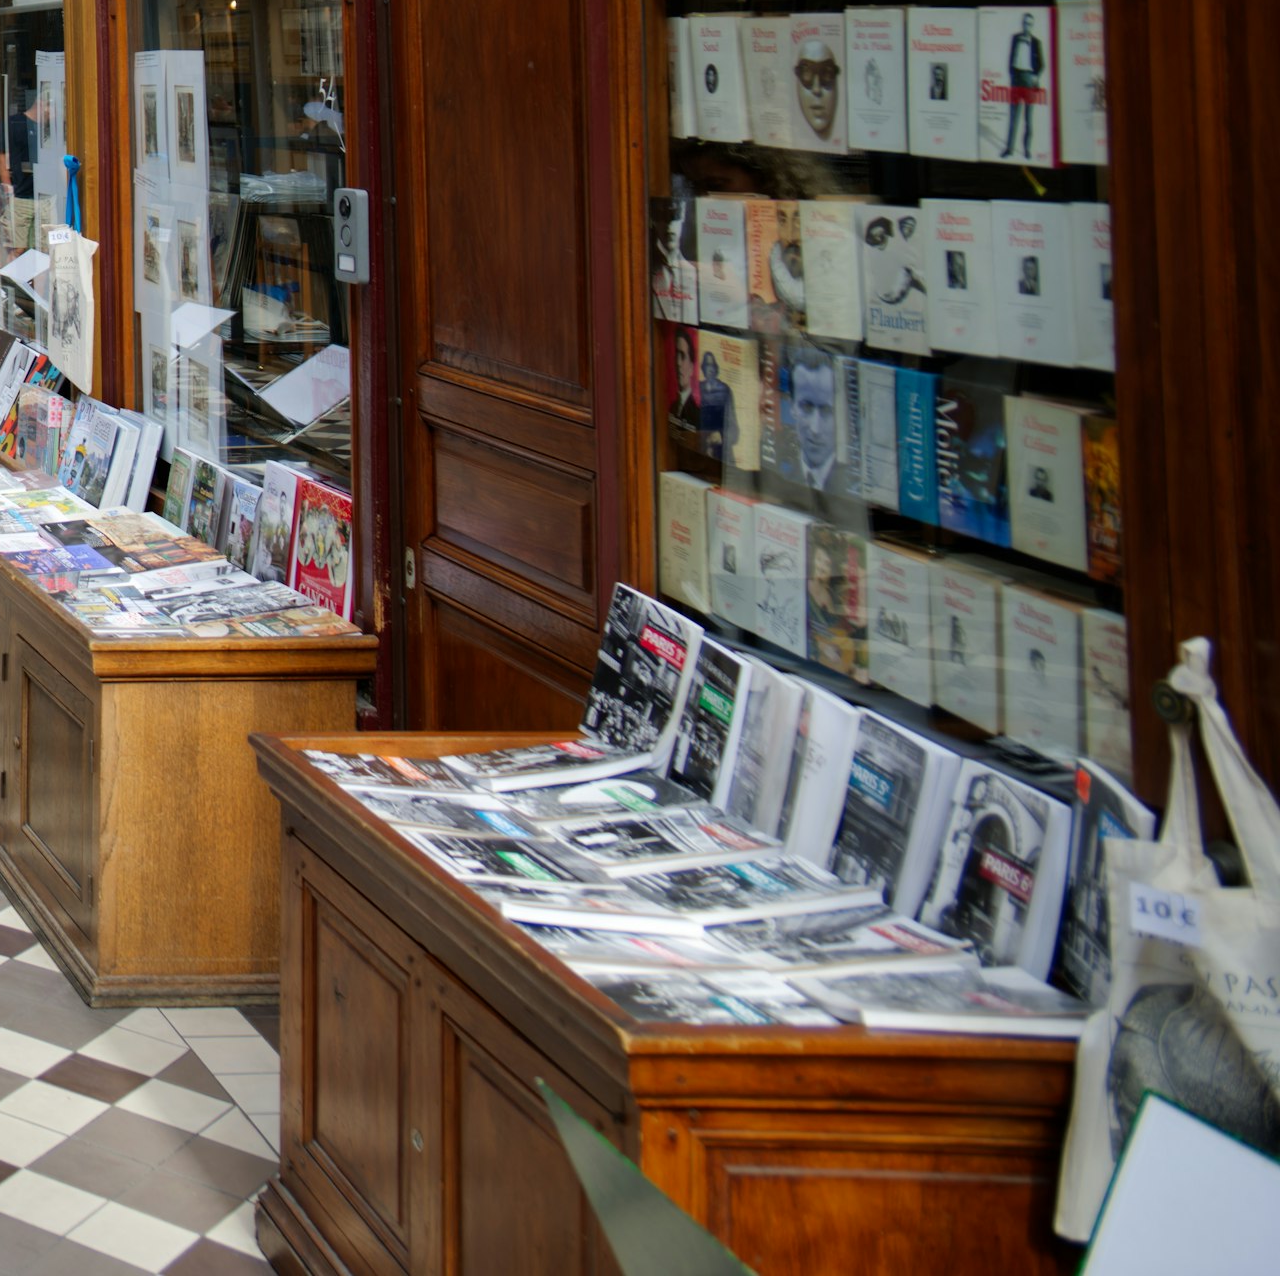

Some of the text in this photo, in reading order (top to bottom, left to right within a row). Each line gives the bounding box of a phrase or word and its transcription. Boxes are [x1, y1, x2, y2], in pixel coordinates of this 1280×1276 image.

[922, 23, 953, 37] Album
[319, 76, 336, 114] 54
[939, 211, 972, 226] Album
[751, 204, 765, 290] Montaigne
[869, 307, 926, 333] Flaubert
[935, 396, 961, 506] Molière
[298, 583, 338, 612] CANCAN
[642, 626, 676, 658] PARIS
[851, 762, 878, 791] PARIS
[984, 852, 1019, 884] PARIS
[1136, 895, 1197, 927] 10 €
